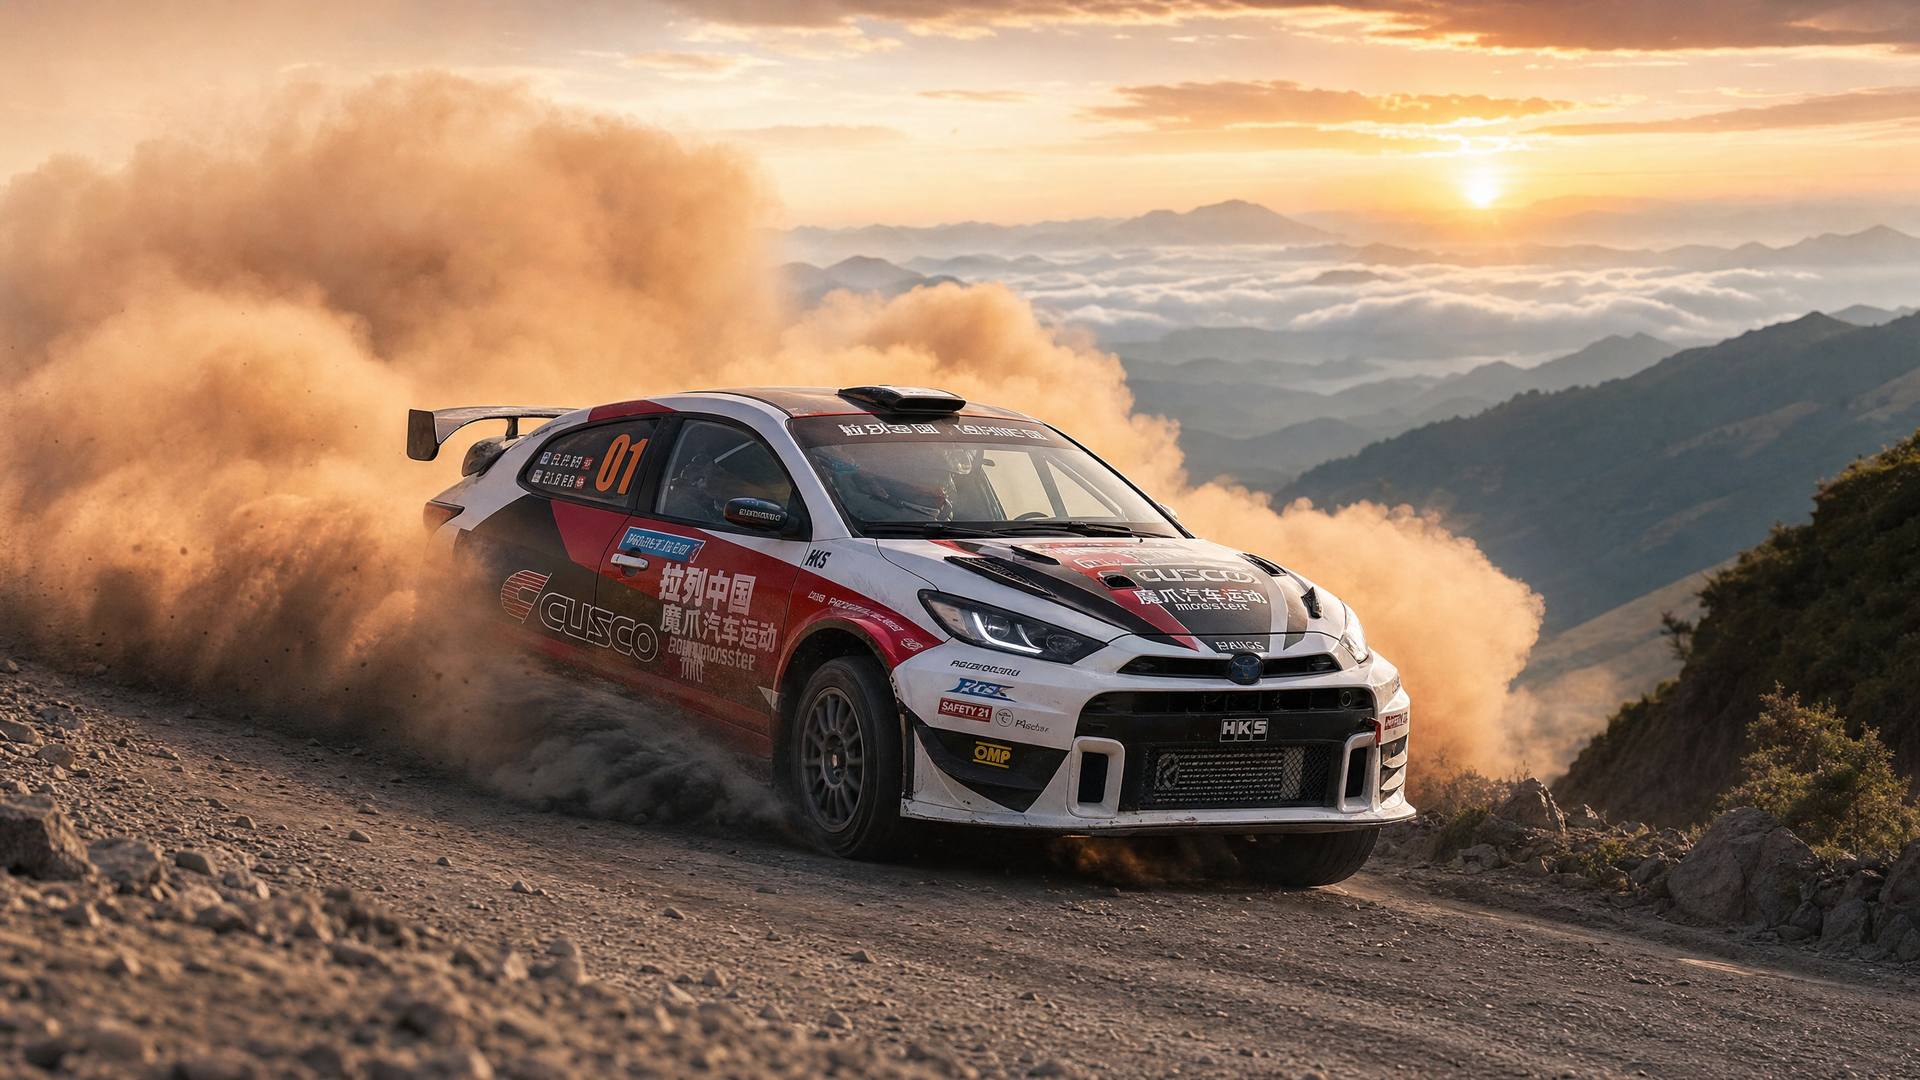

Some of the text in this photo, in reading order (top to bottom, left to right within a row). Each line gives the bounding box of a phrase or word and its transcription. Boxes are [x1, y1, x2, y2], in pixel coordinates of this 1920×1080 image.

[595, 433, 649, 495] 01
[659, 562, 757, 616] 拉列中国
[1133, 587, 1268, 605] 魔爪汽车运动
[539, 592, 659, 662] CUSCO
[660, 603, 777, 653] 魔爪汽车运动
[941, 701, 977, 715] SAFETY
[978, 707, 990, 718] 21
[1222, 720, 1267, 735] HKS
[974, 745, 1011, 763] OMP
